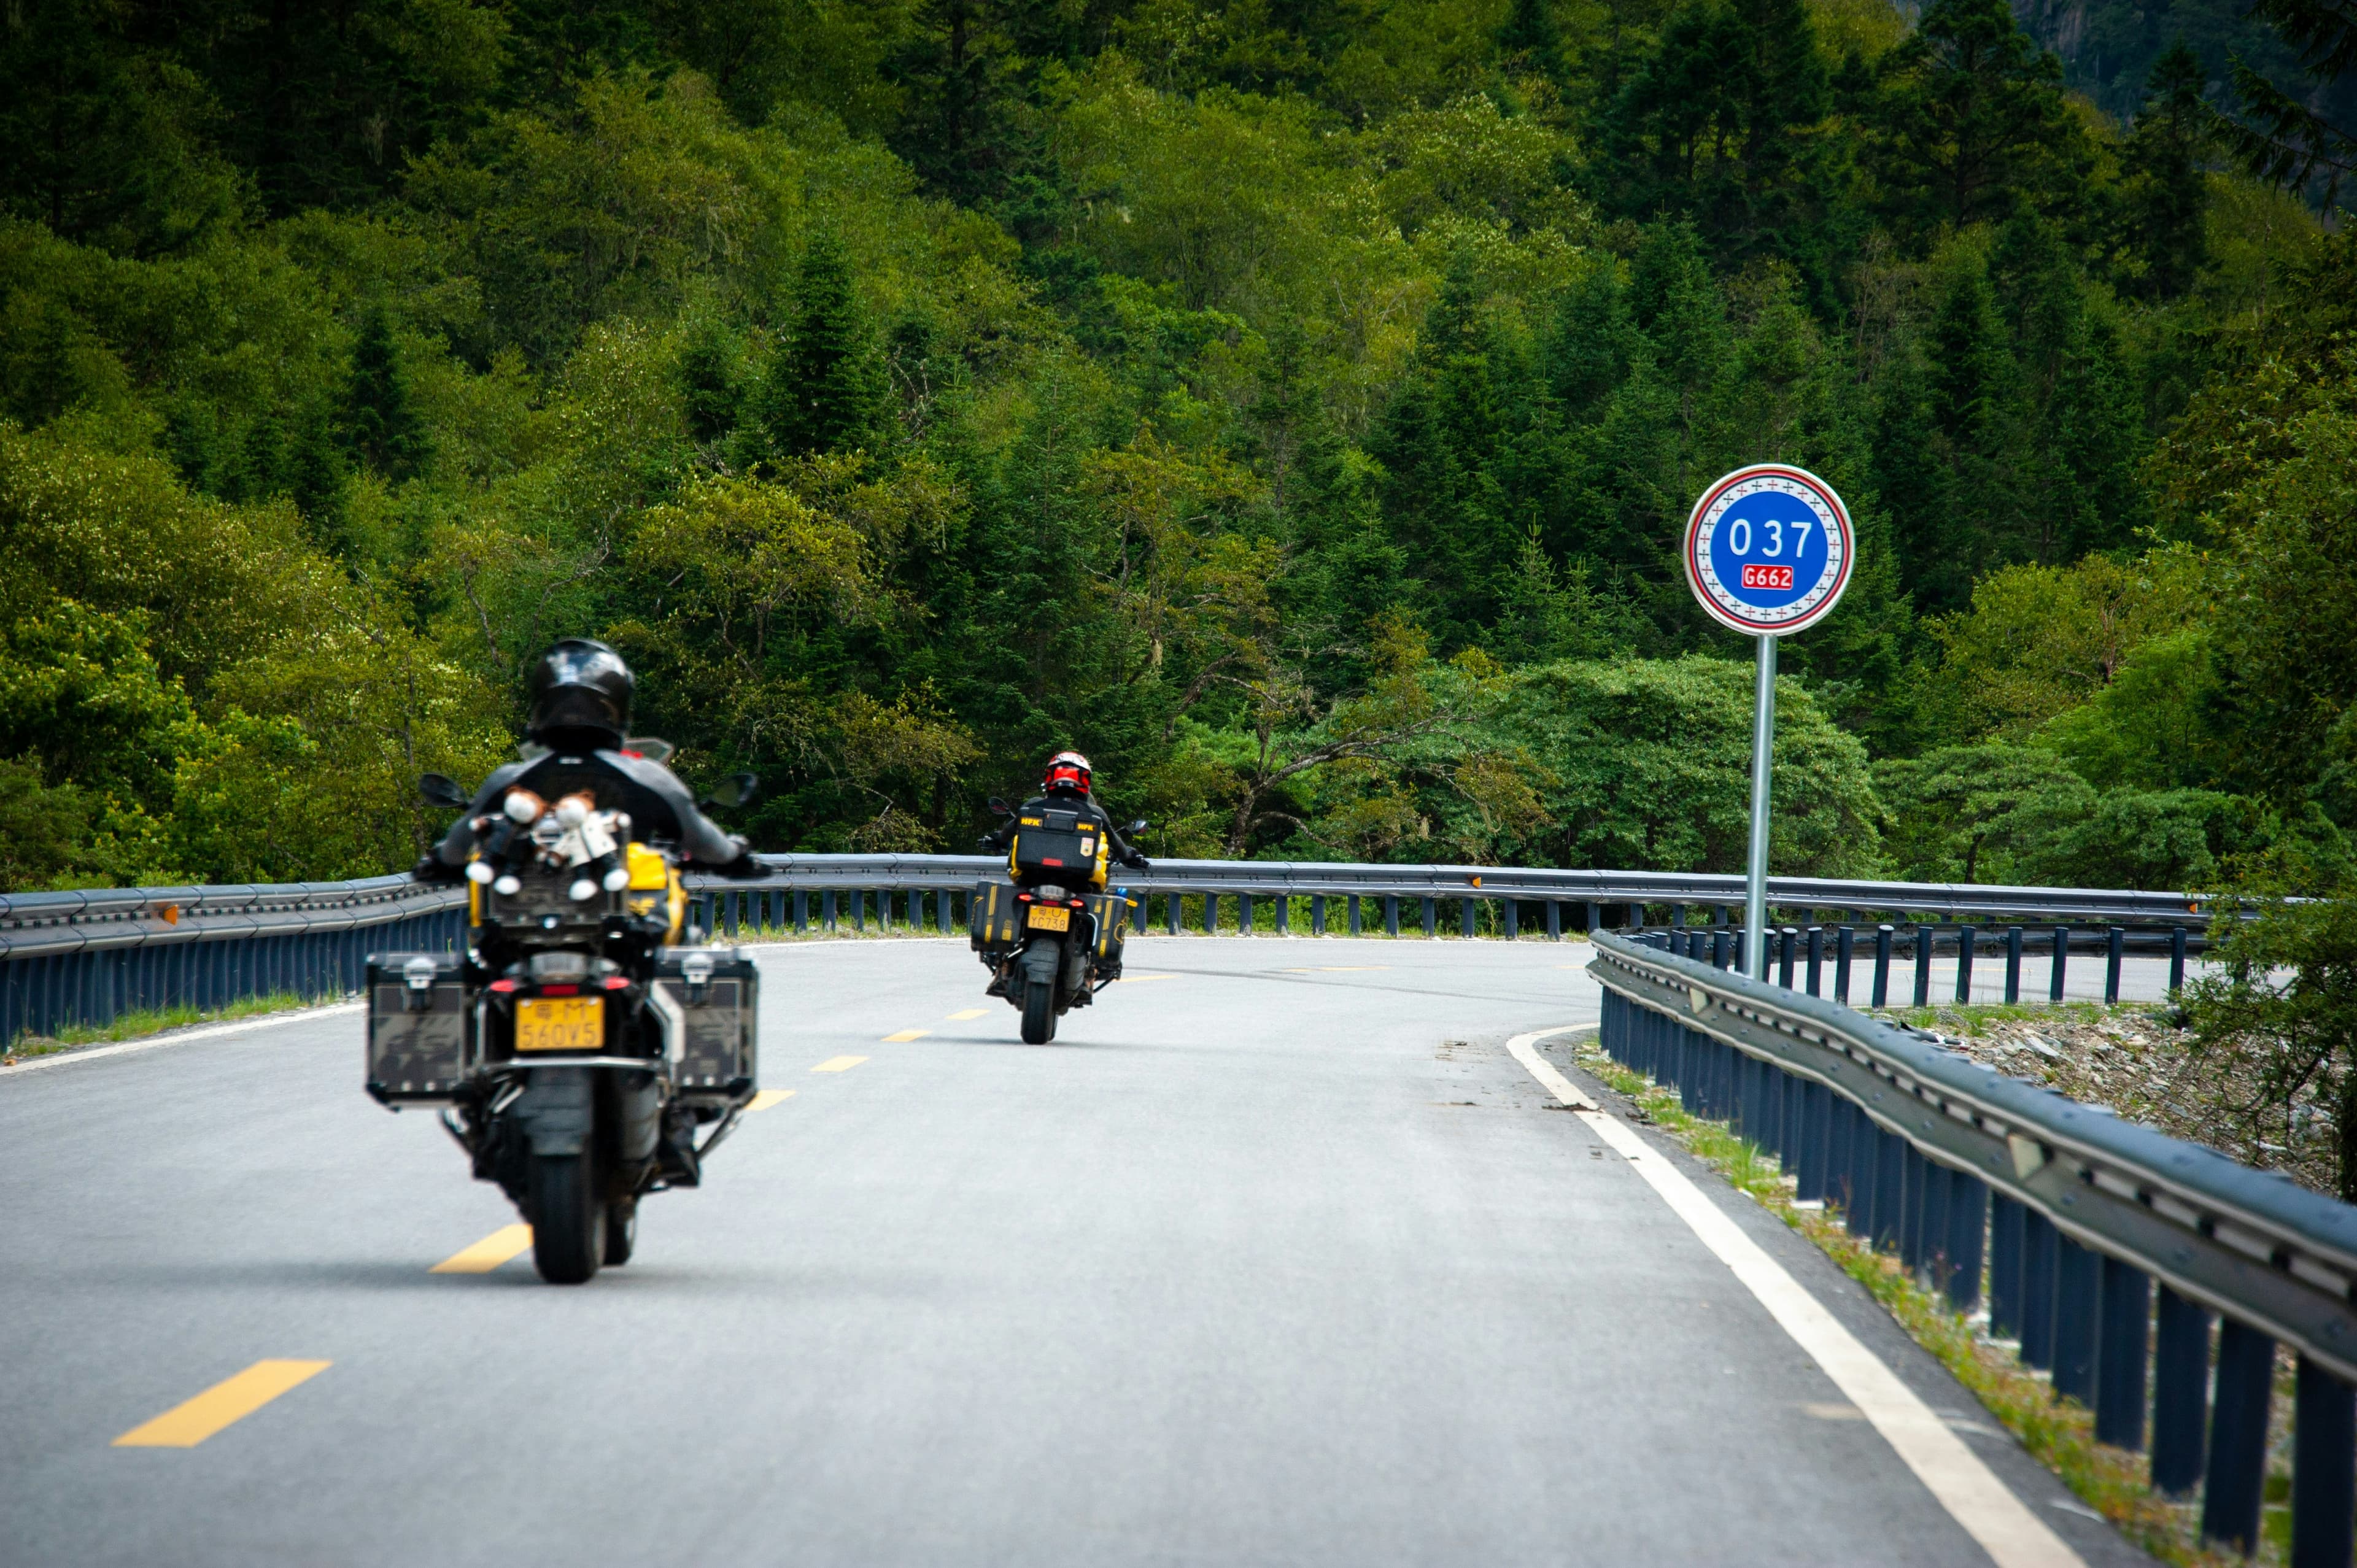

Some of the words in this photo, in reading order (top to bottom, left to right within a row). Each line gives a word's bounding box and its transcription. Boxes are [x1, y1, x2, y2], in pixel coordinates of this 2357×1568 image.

[1729, 519, 1811, 558] 037
[1744, 568, 1791, 587] G662
[1031, 917, 1066, 930] YC738
[522, 1022, 597, 1046] 560V5
